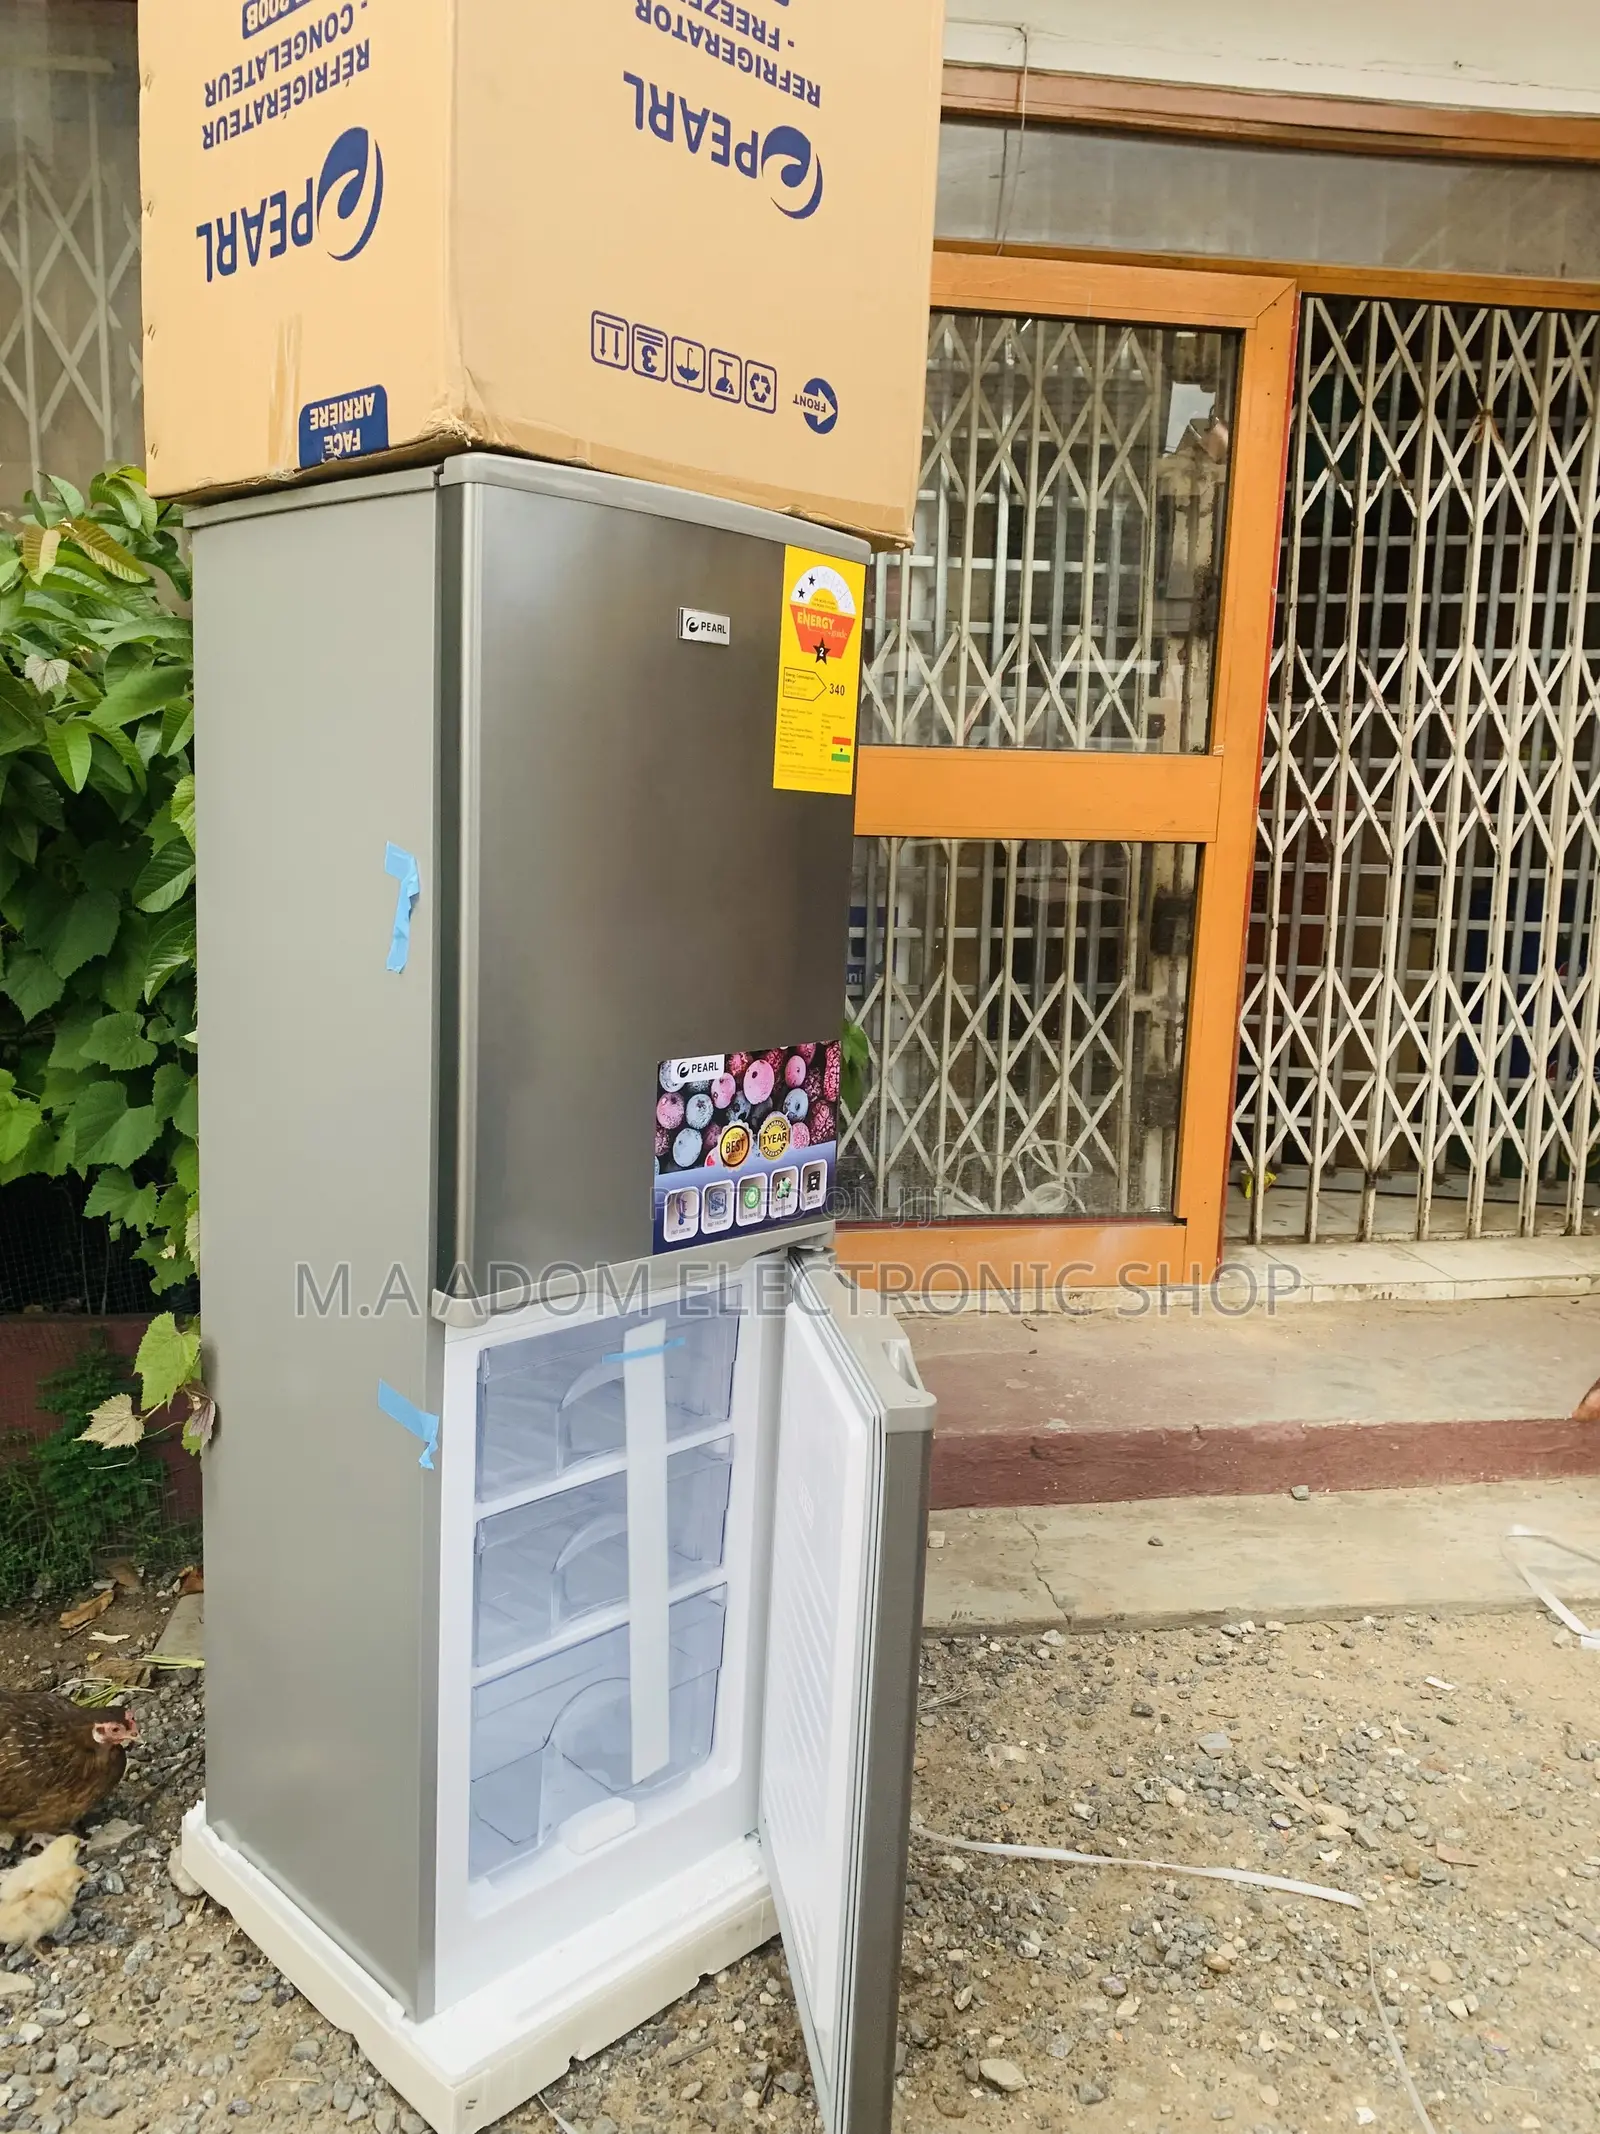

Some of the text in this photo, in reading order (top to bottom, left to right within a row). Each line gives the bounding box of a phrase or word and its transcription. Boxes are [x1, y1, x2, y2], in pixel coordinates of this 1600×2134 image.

[680, 0, 780, 52] FREEZ
[205, 3, 354, 107] CONGELATEUR
[634, 0, 821, 109] REFRIGERATOR
[202, 38, 370, 150] RÉFRIGÉRATEUR
[623, 70, 760, 180] PEARL
[196, 177, 314, 283] PEARL
[309, 392, 375, 431] ARRIÈRE
[792, 393, 827, 413] FRONT
[323, 427, 361, 456] FACE
[700, 621, 727, 635] PEARL
[797, 609, 835, 630] ENERGY
[818, 646, 825, 657] 2
[829, 683, 846, 696] 340
[691, 1062, 719, 1073] PEARL
[726, 1138, 744, 1153] BEST
[762, 1132, 787, 1145] 1 YEAR
